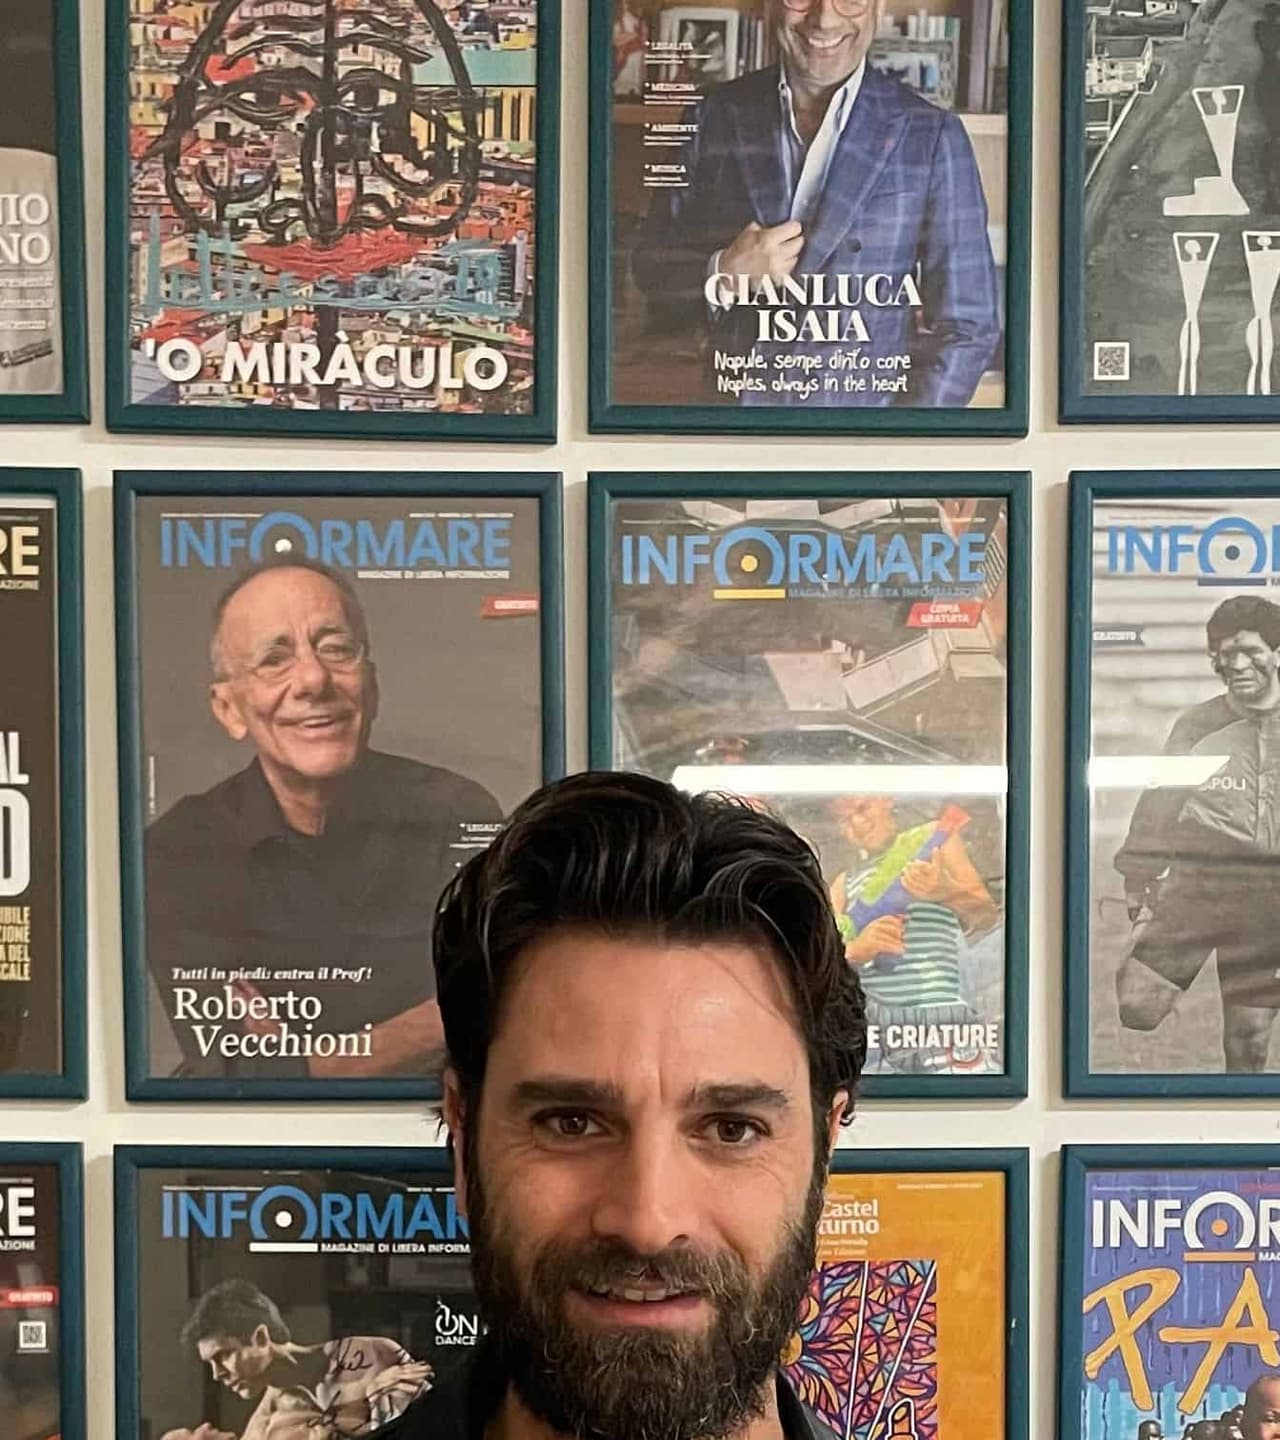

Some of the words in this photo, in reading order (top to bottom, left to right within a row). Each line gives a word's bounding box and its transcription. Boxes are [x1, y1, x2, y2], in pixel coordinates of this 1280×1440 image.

[704, 272, 923, 307] GIANLUCA
[757, 308, 871, 342] ISAIA
[146, 337, 202, 383] 'O
[222, 330, 509, 390] MIRÀCULO
[717, 373, 767, 397] Naples,
[772, 373, 819, 399] always
[824, 373, 838, 391] in
[843, 374, 867, 391] the
[872, 373, 908, 391] heart
[160, 511, 511, 568] INFORMARE
[622, 526, 986, 586] INFORMARE
[171, 967, 208, 981] Tutti
[211, 967, 225, 981] in
[275, 968, 315, 981] entra
[318, 967, 329, 981] il
[173, 987, 322, 1020] Roberto
[191, 1022, 373, 1058] Vecchioni
[886, 1023, 999, 1050] CRIATURE
[162, 1185, 470, 1240] INFORMAR
[819, 1199, 878, 1218] Castel
[435, 1335, 478, 1347] DANCE
